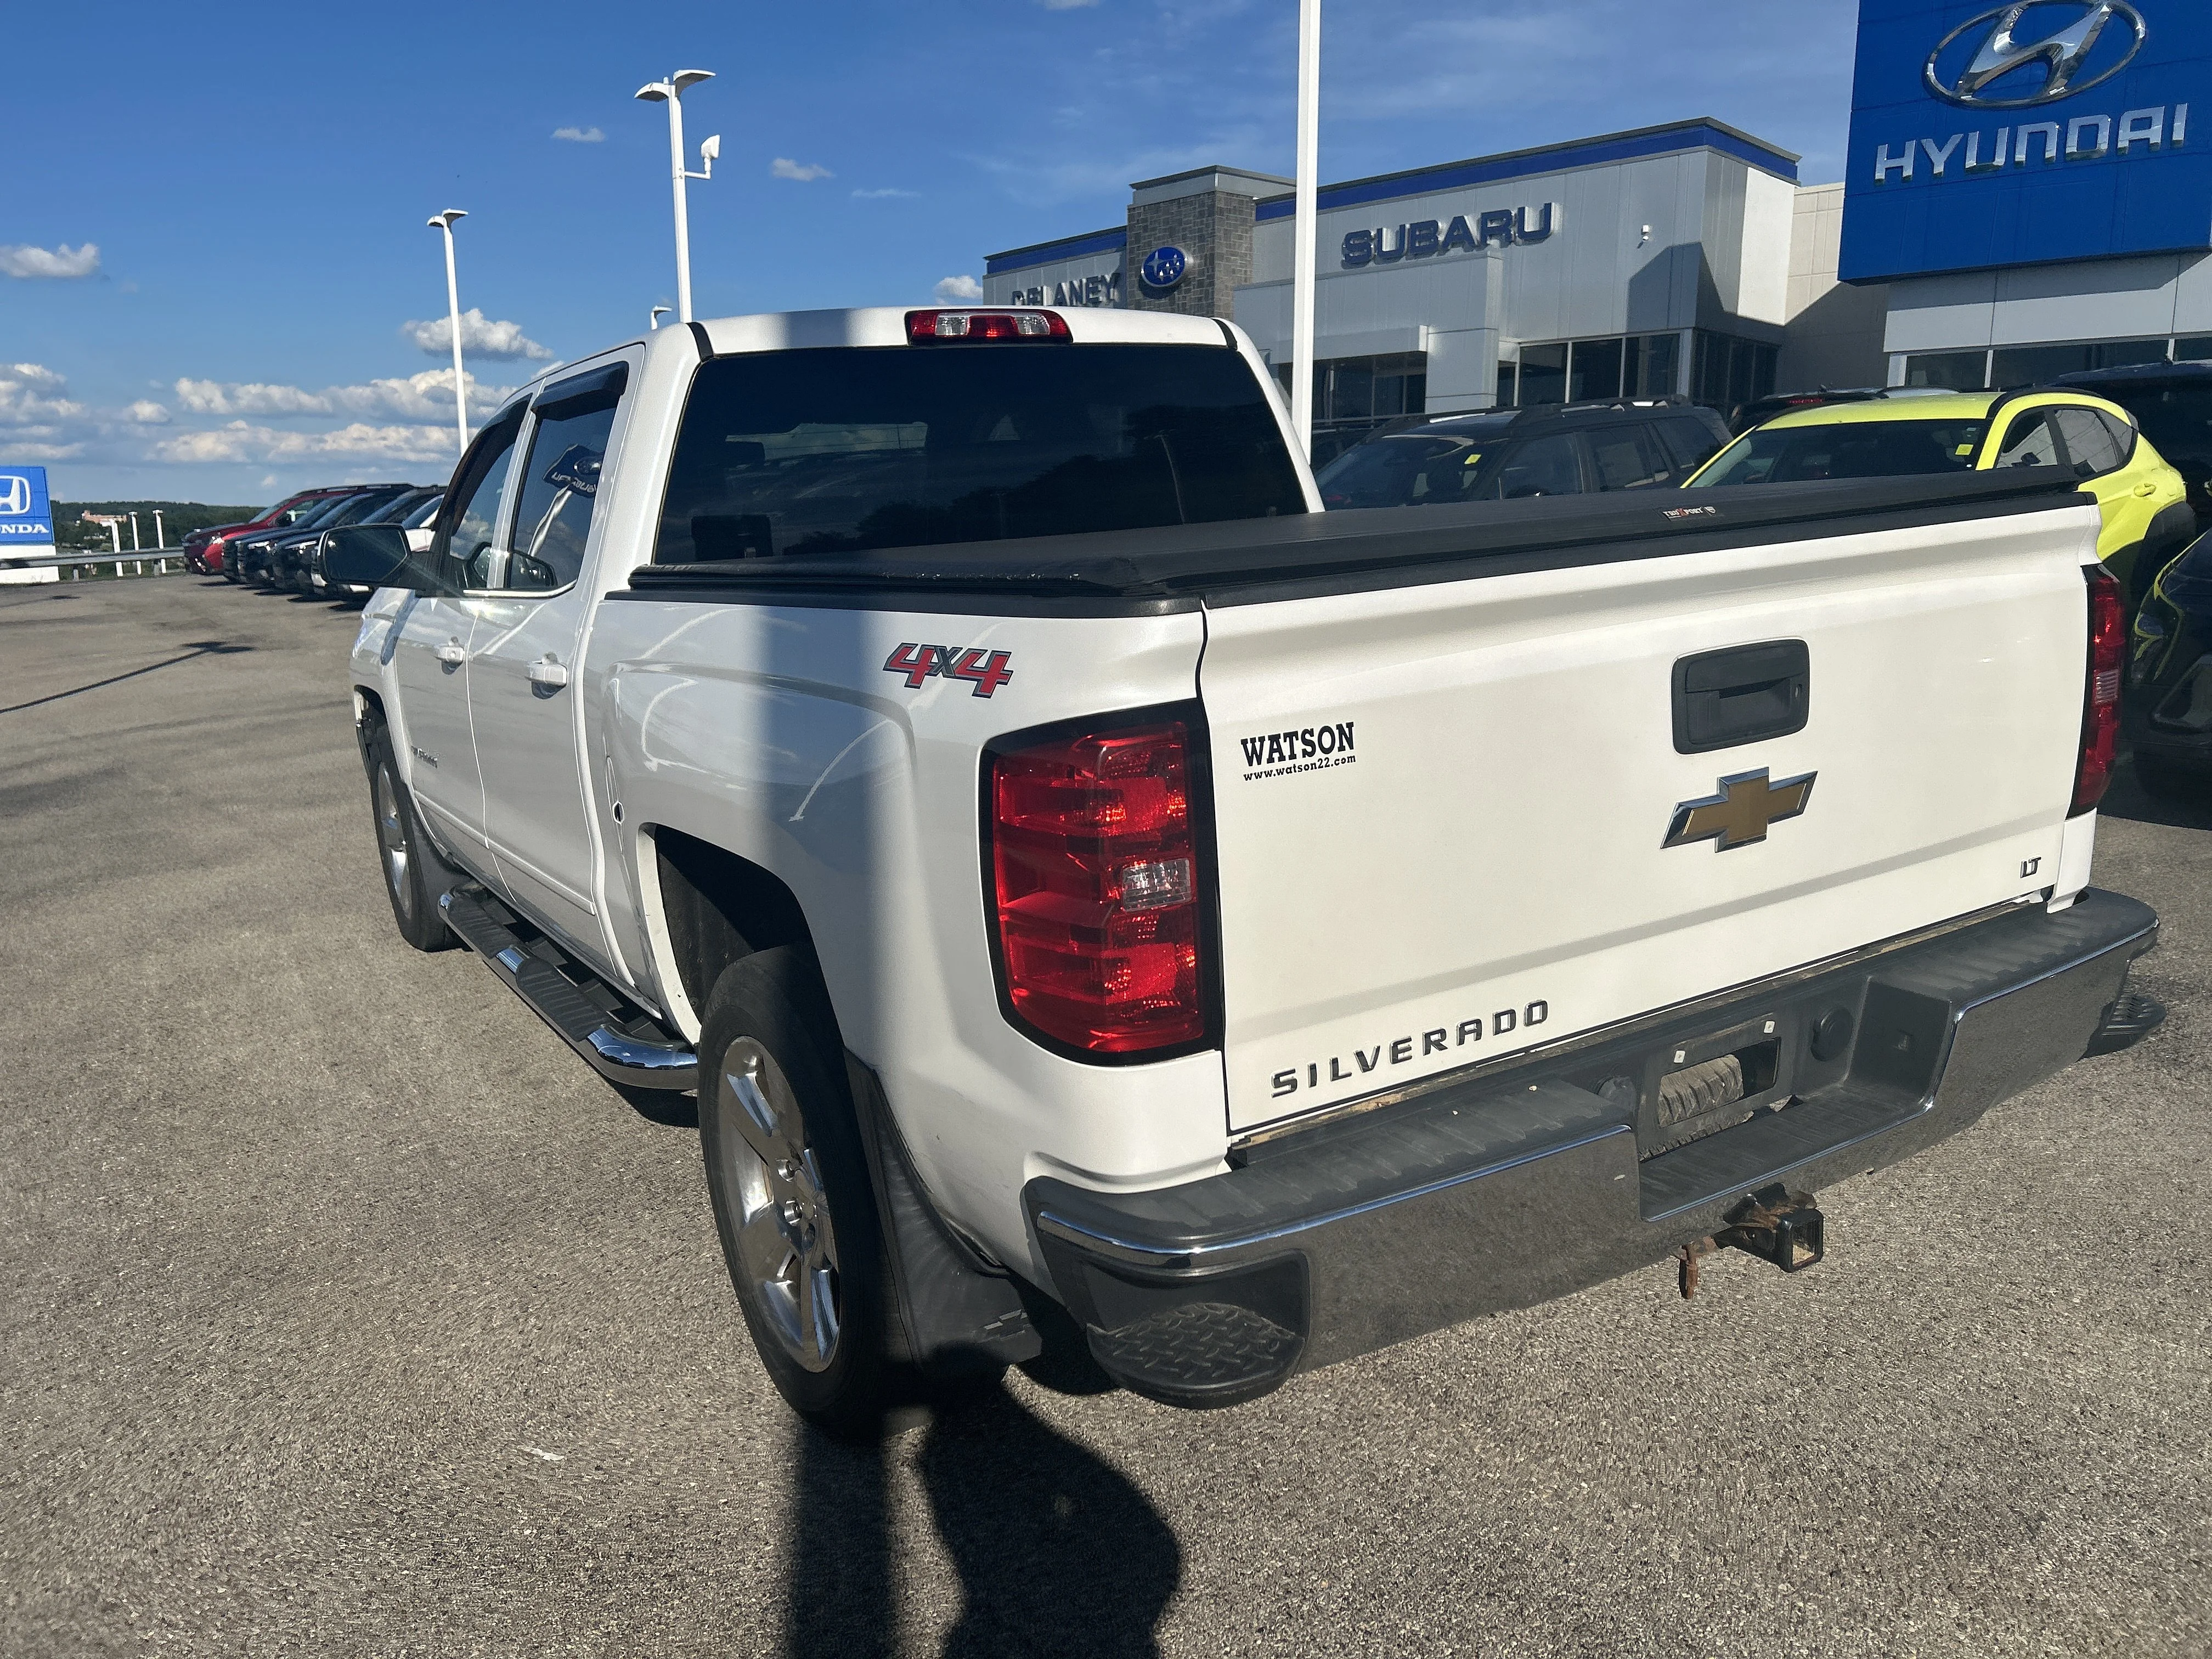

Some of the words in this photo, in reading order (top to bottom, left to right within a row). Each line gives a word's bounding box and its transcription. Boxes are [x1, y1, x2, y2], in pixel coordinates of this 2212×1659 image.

[1874, 103, 2188, 184] HYUNDAI
[1342, 202, 1552, 268] SUBARU
[1240, 721, 1355, 767] WATSON
[1243, 755, 1356, 781] www.watson22.com
[2020, 856, 2041, 878] LT
[1271, 1000, 1548, 1098] SILVERADO
